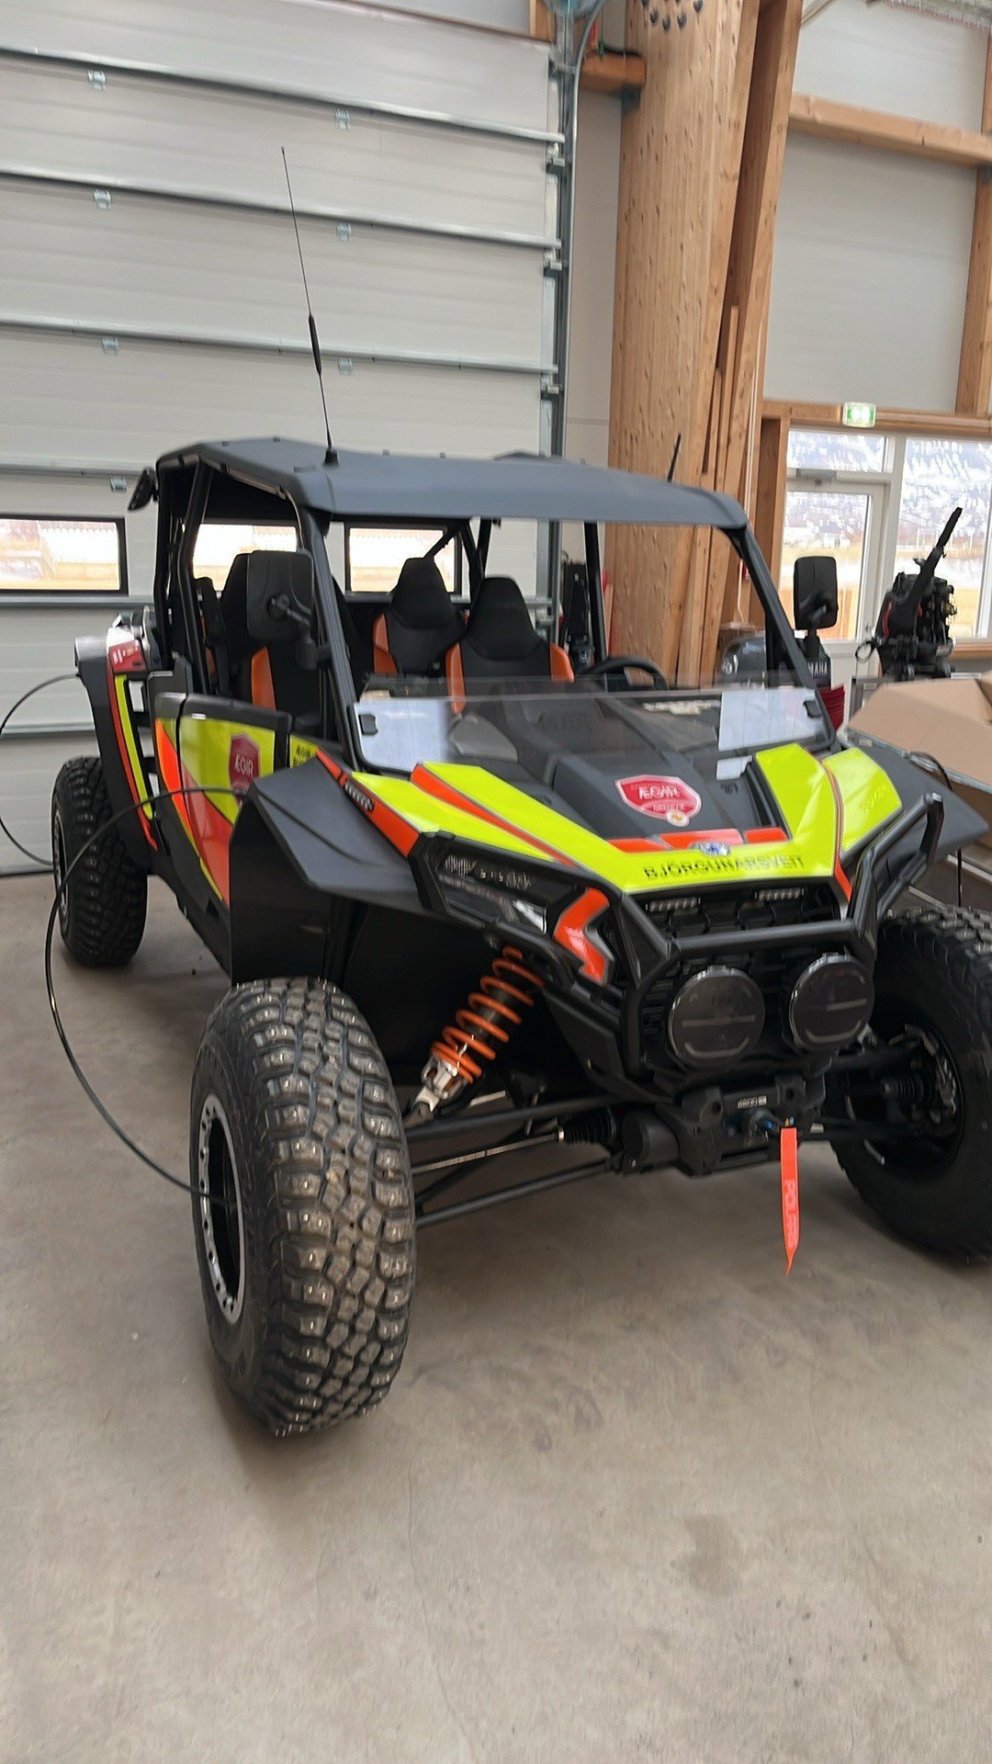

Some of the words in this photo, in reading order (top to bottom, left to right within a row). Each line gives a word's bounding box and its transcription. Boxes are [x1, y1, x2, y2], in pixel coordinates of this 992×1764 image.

[807, 661, 828, 677] MAHA
[234, 752, 254, 779] ÆGIR
[638, 785, 680, 800] ÆGIR
[643, 855, 804, 880] BJÖRGUNARSVEIT
